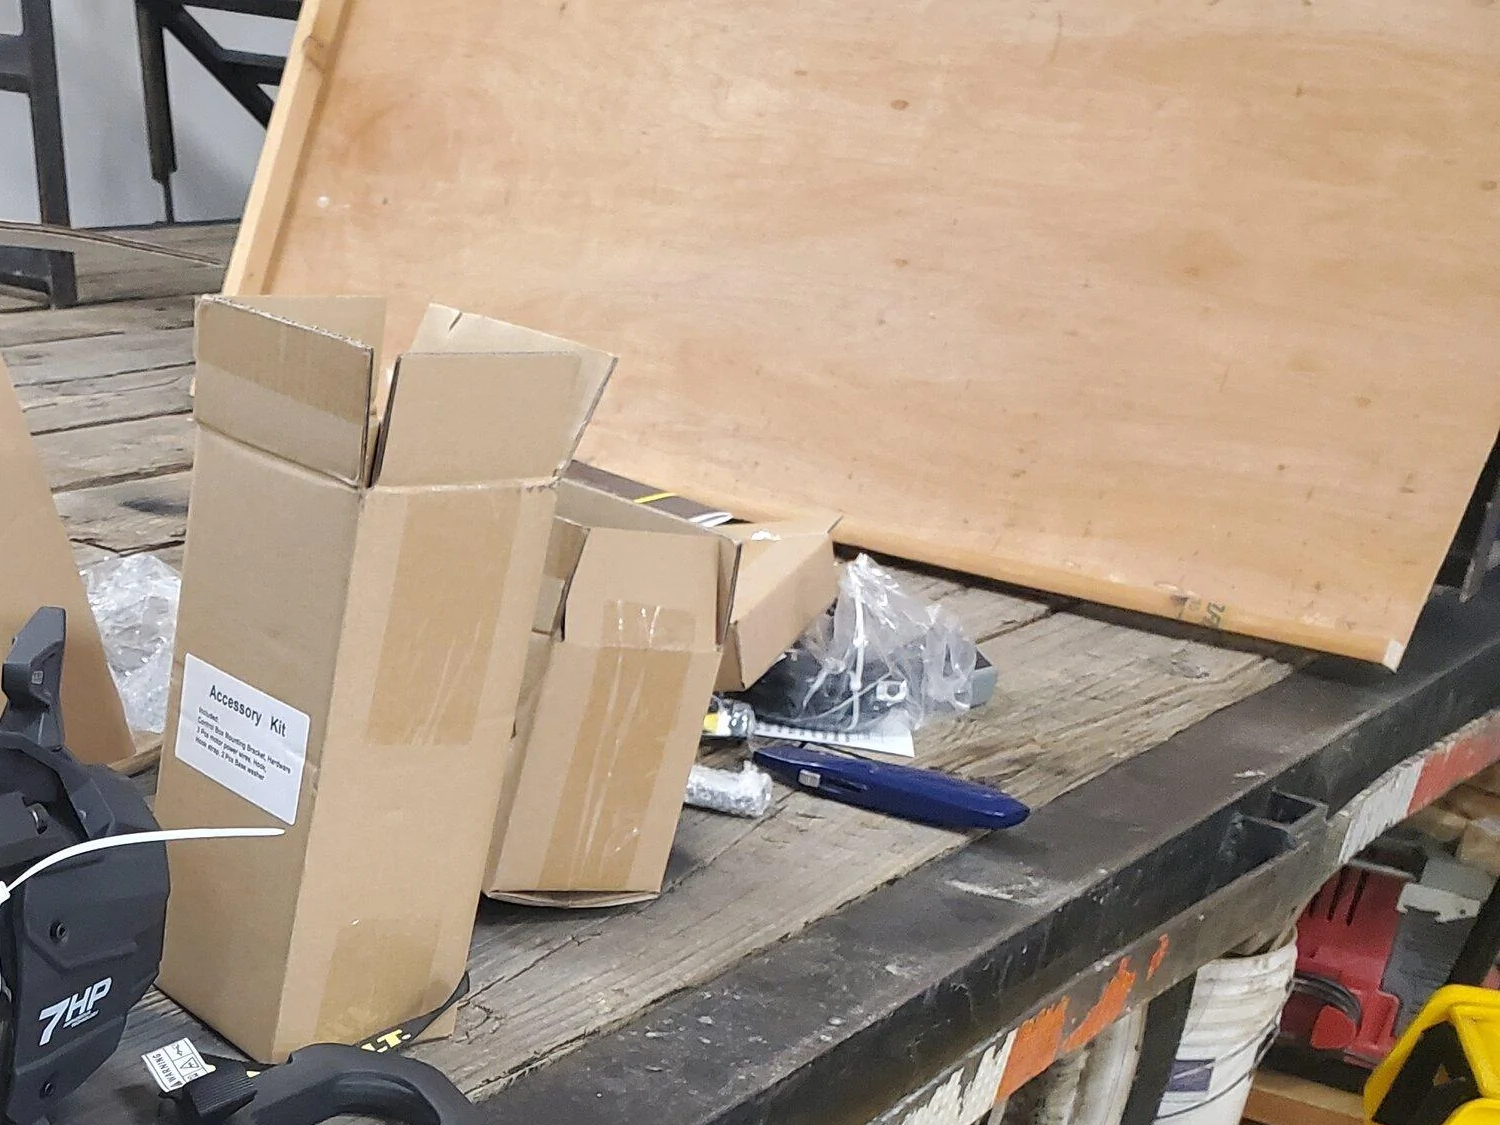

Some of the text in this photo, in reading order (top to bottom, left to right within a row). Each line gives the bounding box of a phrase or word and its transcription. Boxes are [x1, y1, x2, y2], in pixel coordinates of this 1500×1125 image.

[209, 684, 286, 737] Accessory Kit
[39, 977, 112, 1046] 7HP
[152, 1053, 177, 1083] WARNING
